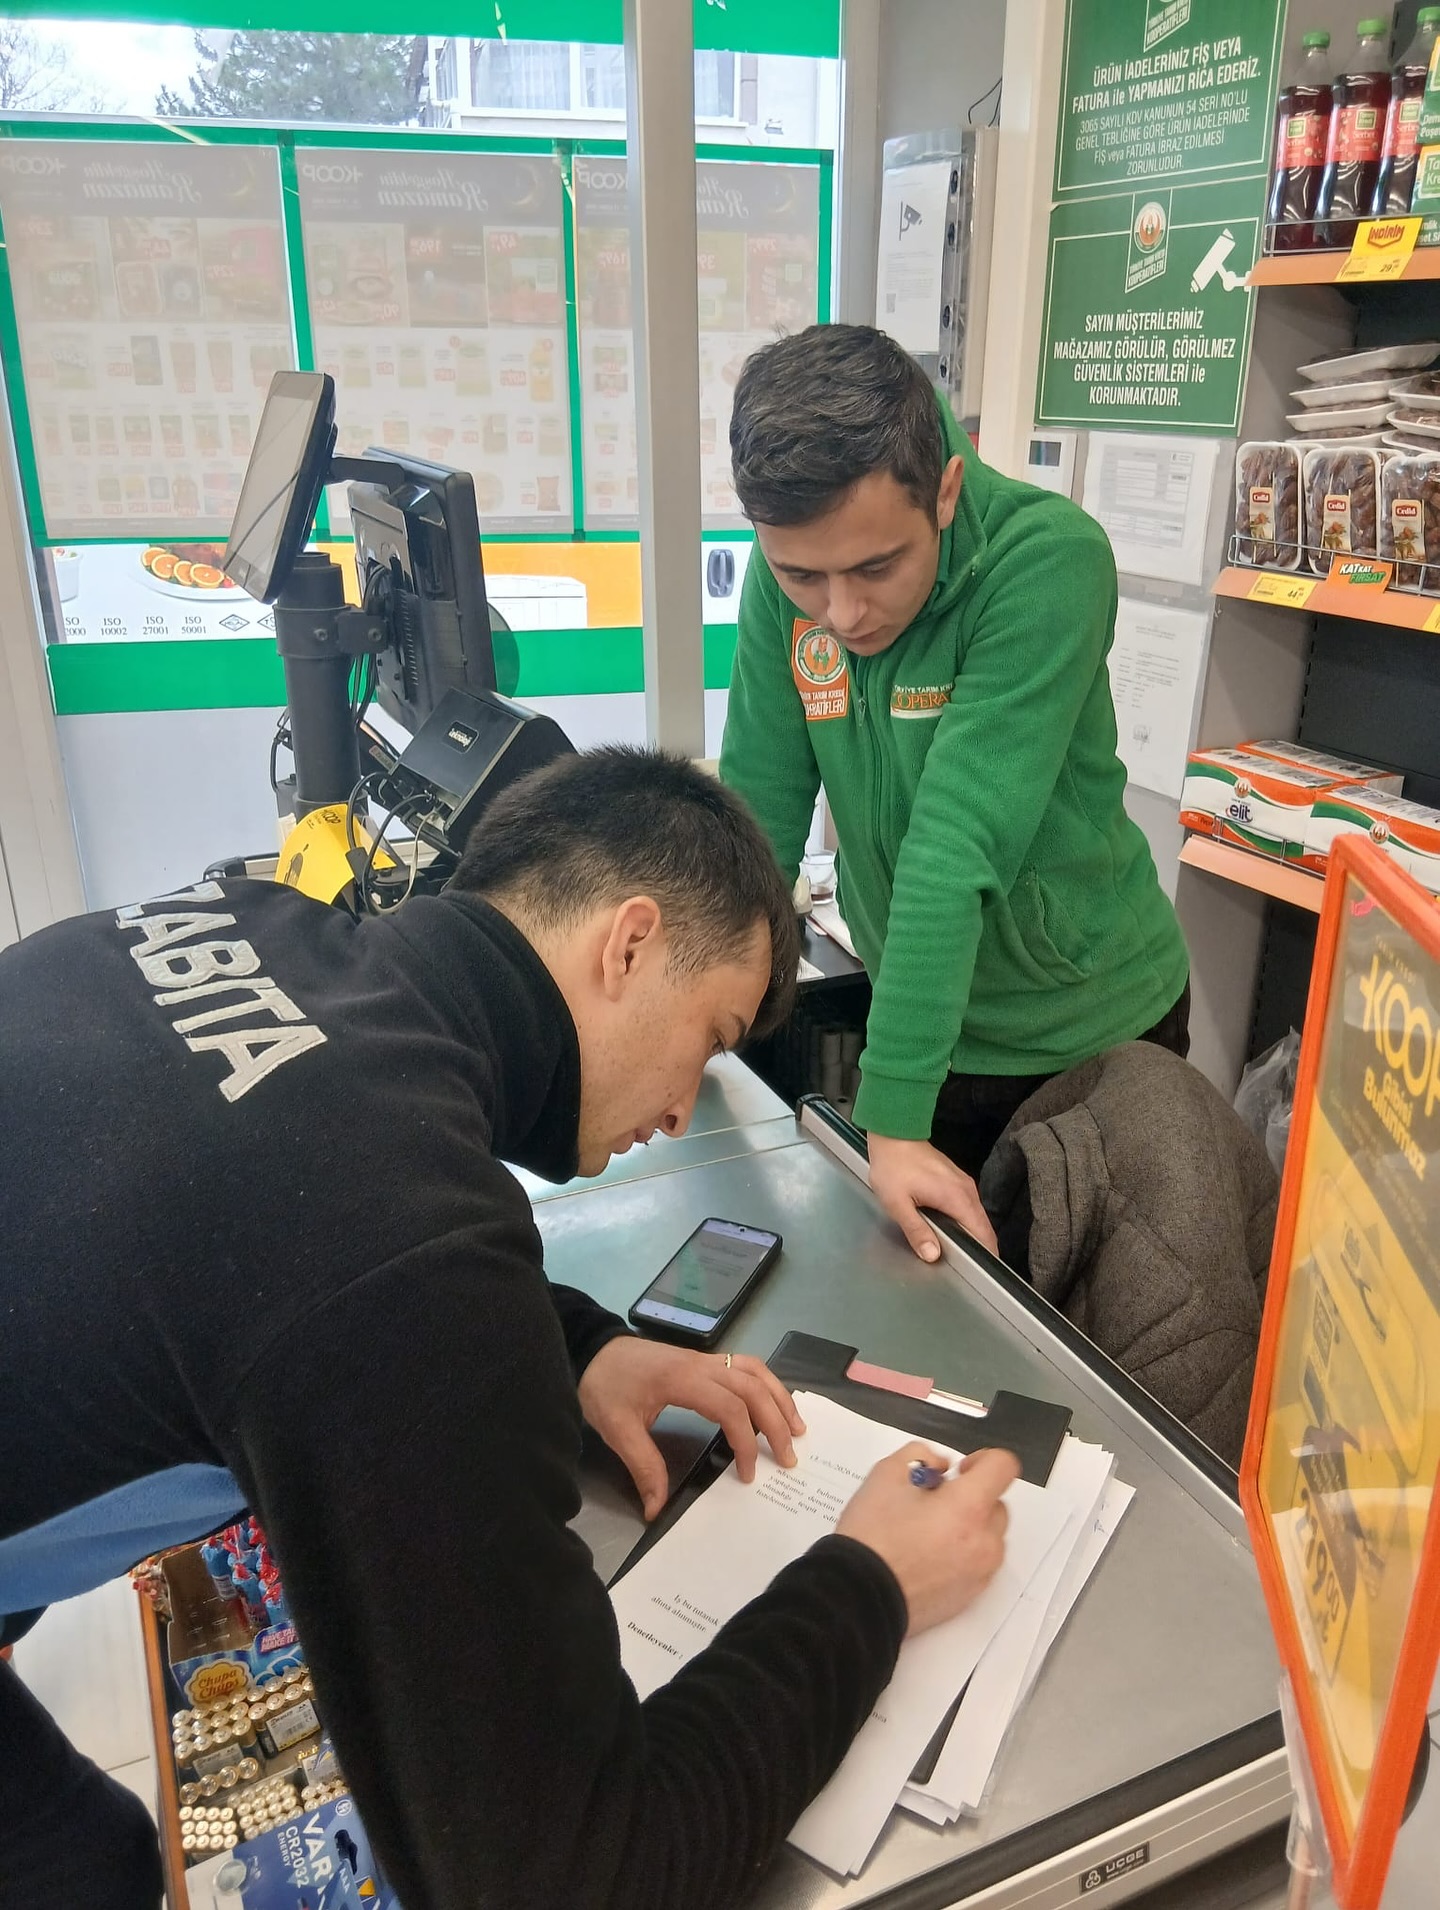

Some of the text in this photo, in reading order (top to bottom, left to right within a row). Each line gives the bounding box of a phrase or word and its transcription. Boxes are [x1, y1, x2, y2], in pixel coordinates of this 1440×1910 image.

[1093, 36, 1241, 87] ÜRÜN İADELERİNİZ FİŞ VEYA
[1072, 55, 1261, 114] FATURA ile YAPMANIZI RİCA EDERİZ.
[1080, 89, 1248, 134] 3065 SAYILI KDV KANUNUN 54 SERİ NO'LU
[1076, 107, 1250, 151] GENEL TEBLİĞİNE GÖRE ÜRÜN İADELERİNDE
[1094, 129, 1225, 166] FİŞ veya FATURA İBRAZ EDİLMESİ
[1126, 154, 1184, 176] ZORUNLUDUR.
[1085, 306, 1204, 335] SAYIN MÜŞTERİLERİMİZ
[1054, 334, 1236, 361] MAĞAZAMIZ GÖRÜLÜR, GÖRÜLMEZ
[1074, 359, 1205, 383] GÜVENLİK SİSTEMLERİ ile
[1089, 385, 1181, 406] KORUNMAKTADIR.
[65, 616, 80, 626] SO
[103, 617, 121, 626] ISO
[143, 626, 169, 635] 27001
[146, 616, 164, 625] ISO
[181, 625, 207, 635] 50001
[184, 615, 202, 625] ISO
[101, 626, 128, 636] 10002
[1229, 803, 1252, 821] elit
[692, 1606, 720, 1627] tutanak
[198, 1668, 238, 1689] Chupa
[199, 1679, 241, 1700] Chups
[276, 1831, 293, 1868] ENERGY
[284, 1825, 311, 1889] CR2032
